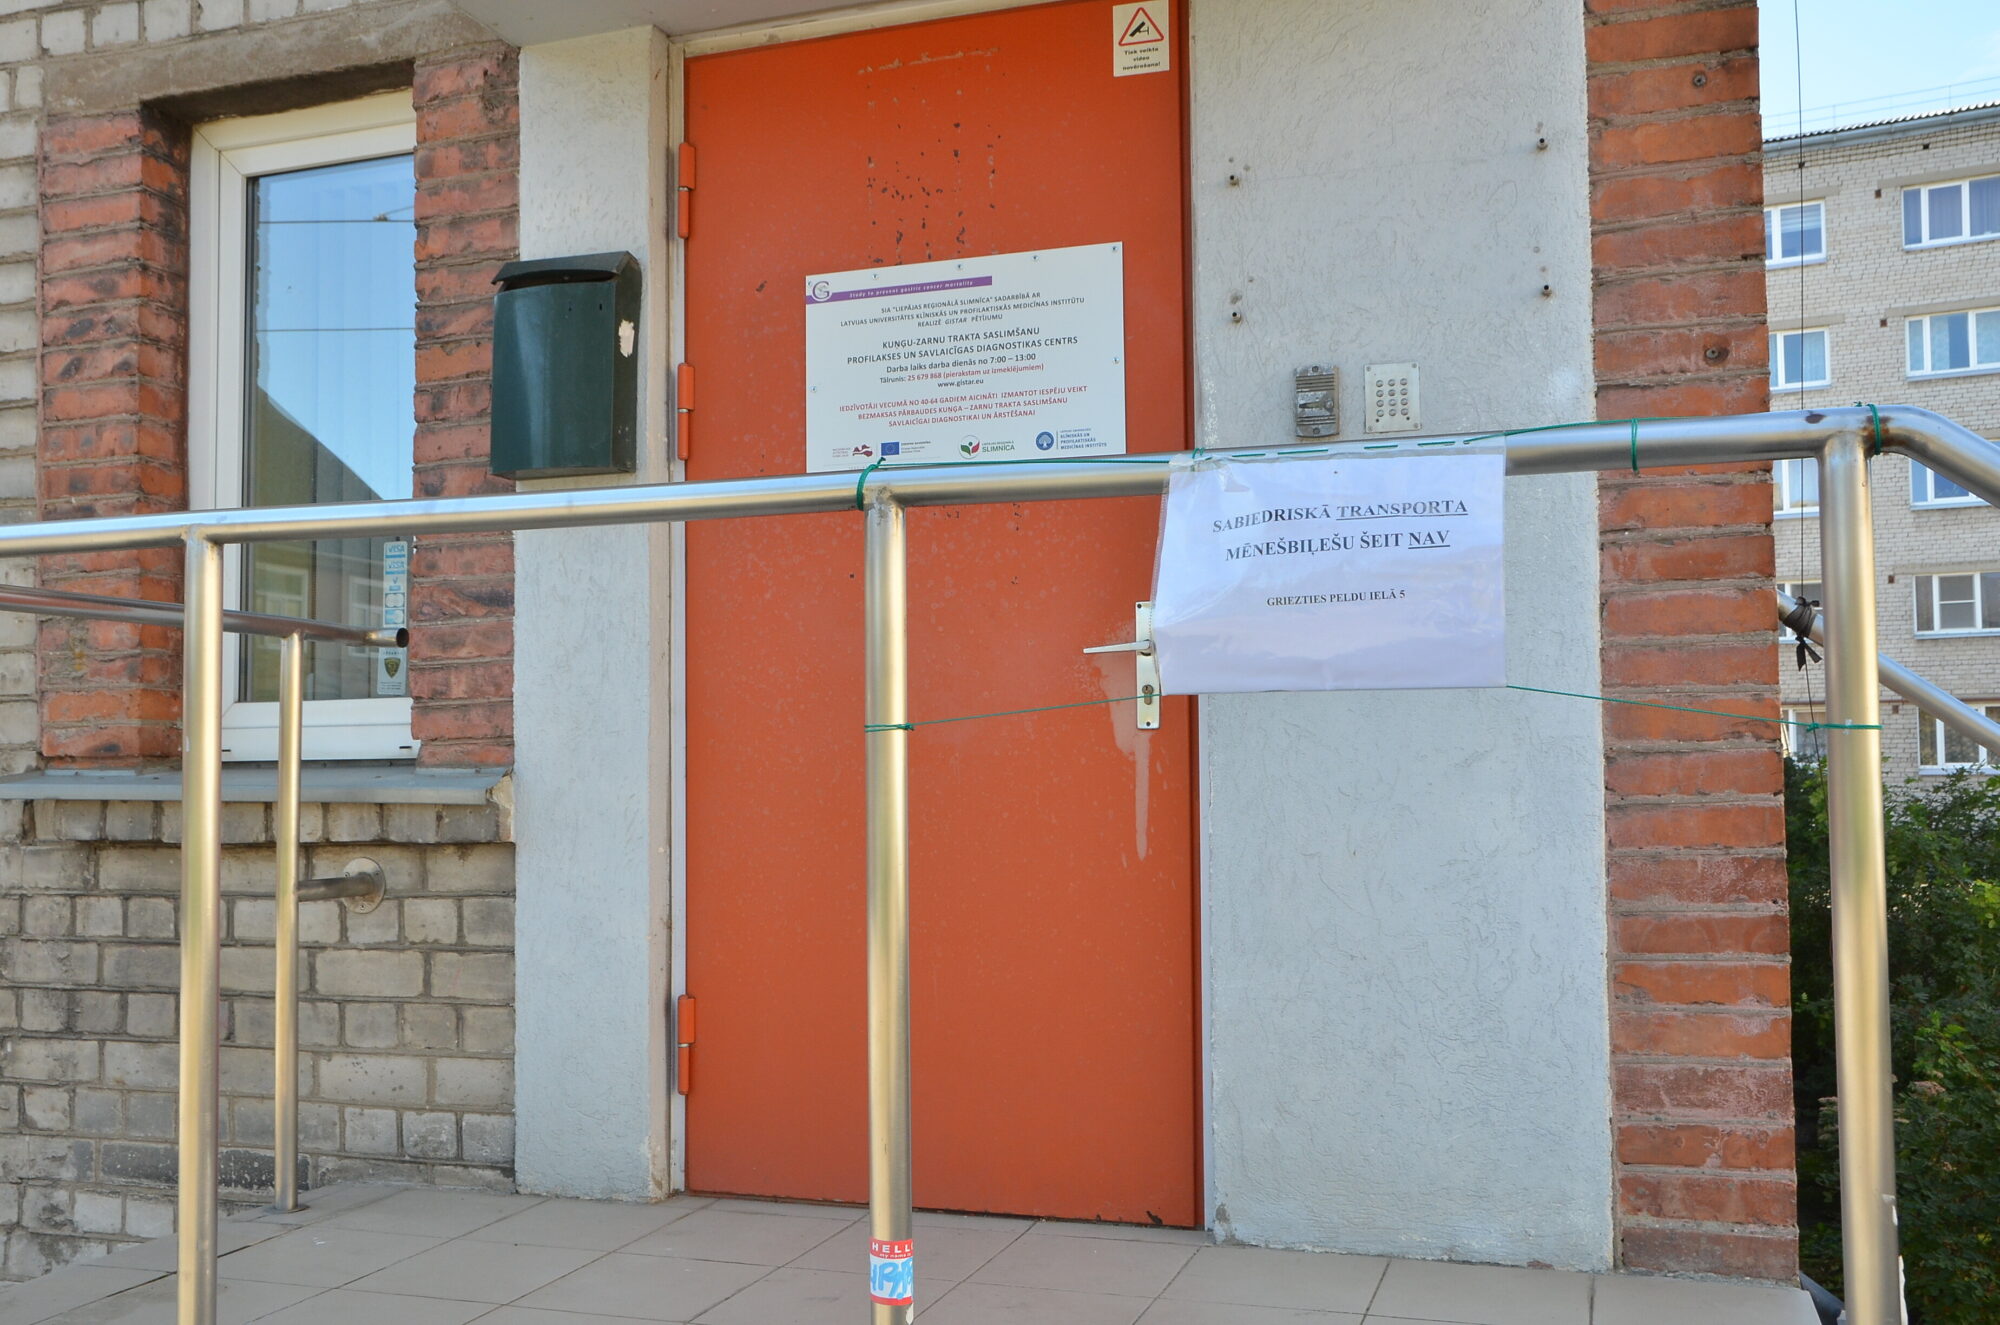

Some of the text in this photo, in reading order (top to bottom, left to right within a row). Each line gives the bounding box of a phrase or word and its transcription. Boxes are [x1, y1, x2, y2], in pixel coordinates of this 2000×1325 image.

[900, 286, 922, 294] gastric
[945, 280, 973, 288] mortality
[840, 318, 868, 327] LATVIJAS
[870, 312, 914, 324] UNIVERSITĀTES
[916, 309, 947, 320] KLĪNISKĀS
[960, 304, 1012, 316] PROFILAKTISKĀS
[1013, 300, 1049, 310] MEDICĪNAS
[1050, 296, 1085, 306] INSTITŪTU
[892, 304, 922, 313] "LIEPĀJAS
[923, 300, 959, 310] REĢIONĀLĀ
[960, 296, 993, 306] SLIMNĪCA"
[994, 292, 1030, 302] SADARBĪBĀ
[918, 317, 942, 327] REALIZĒ
[971, 314, 1003, 322] PĒTĪJUMU
[882, 327, 1040, 350] KUŅĢU-ZARNU TRAKTA SASLIMŠANU
[848, 336, 1078, 364] PROFILAKSES UN SAVLAICĪGAS DIAGNOSTIKAS CENTRS
[952, 359, 976, 367] dienās
[990, 355, 1006, 364] 7:00
[1015, 353, 1036, 362] 13:00
[943, 369, 981, 380] (pierakstam
[991, 364, 1044, 374] izmeklējumiem)
[938, 379, 984, 388] www.gistar.eu
[840, 403, 878, 412] IEDZĪVOTĀJI
[880, 400, 908, 409] VECUMĀ
[968, 393, 998, 402] AICINĀTI
[1001, 390, 1038, 398] IZMANTOT
[1039, 386, 1066, 395] IESPĒJU
[858, 411, 896, 420] BEZMAKSAS
[898, 407, 936, 417] PĀRBAUDES
[938, 406, 962, 414] KUŅĢA
[995, 401, 1022, 409] TRAKTA
[1023, 397, 1068, 407] SASLIMŠANU
[888, 418, 930, 427] SAVLAICĪGAI
[931, 415, 980, 424] DIAGNOSTIKAI
[993, 410, 1036, 419] ĀRSTĒŠANAI
[982, 444, 1015, 452] SLIMNĪCA
[1212, 500, 1468, 532] SABIEDRISKĀ TRANSPORTA
[1225, 530, 1450, 561] MĒNEŠBIĻEŠU ŠEIT NAV
[1267, 589, 1406, 606] GRIEZTIES PELDU IELĀ 5
